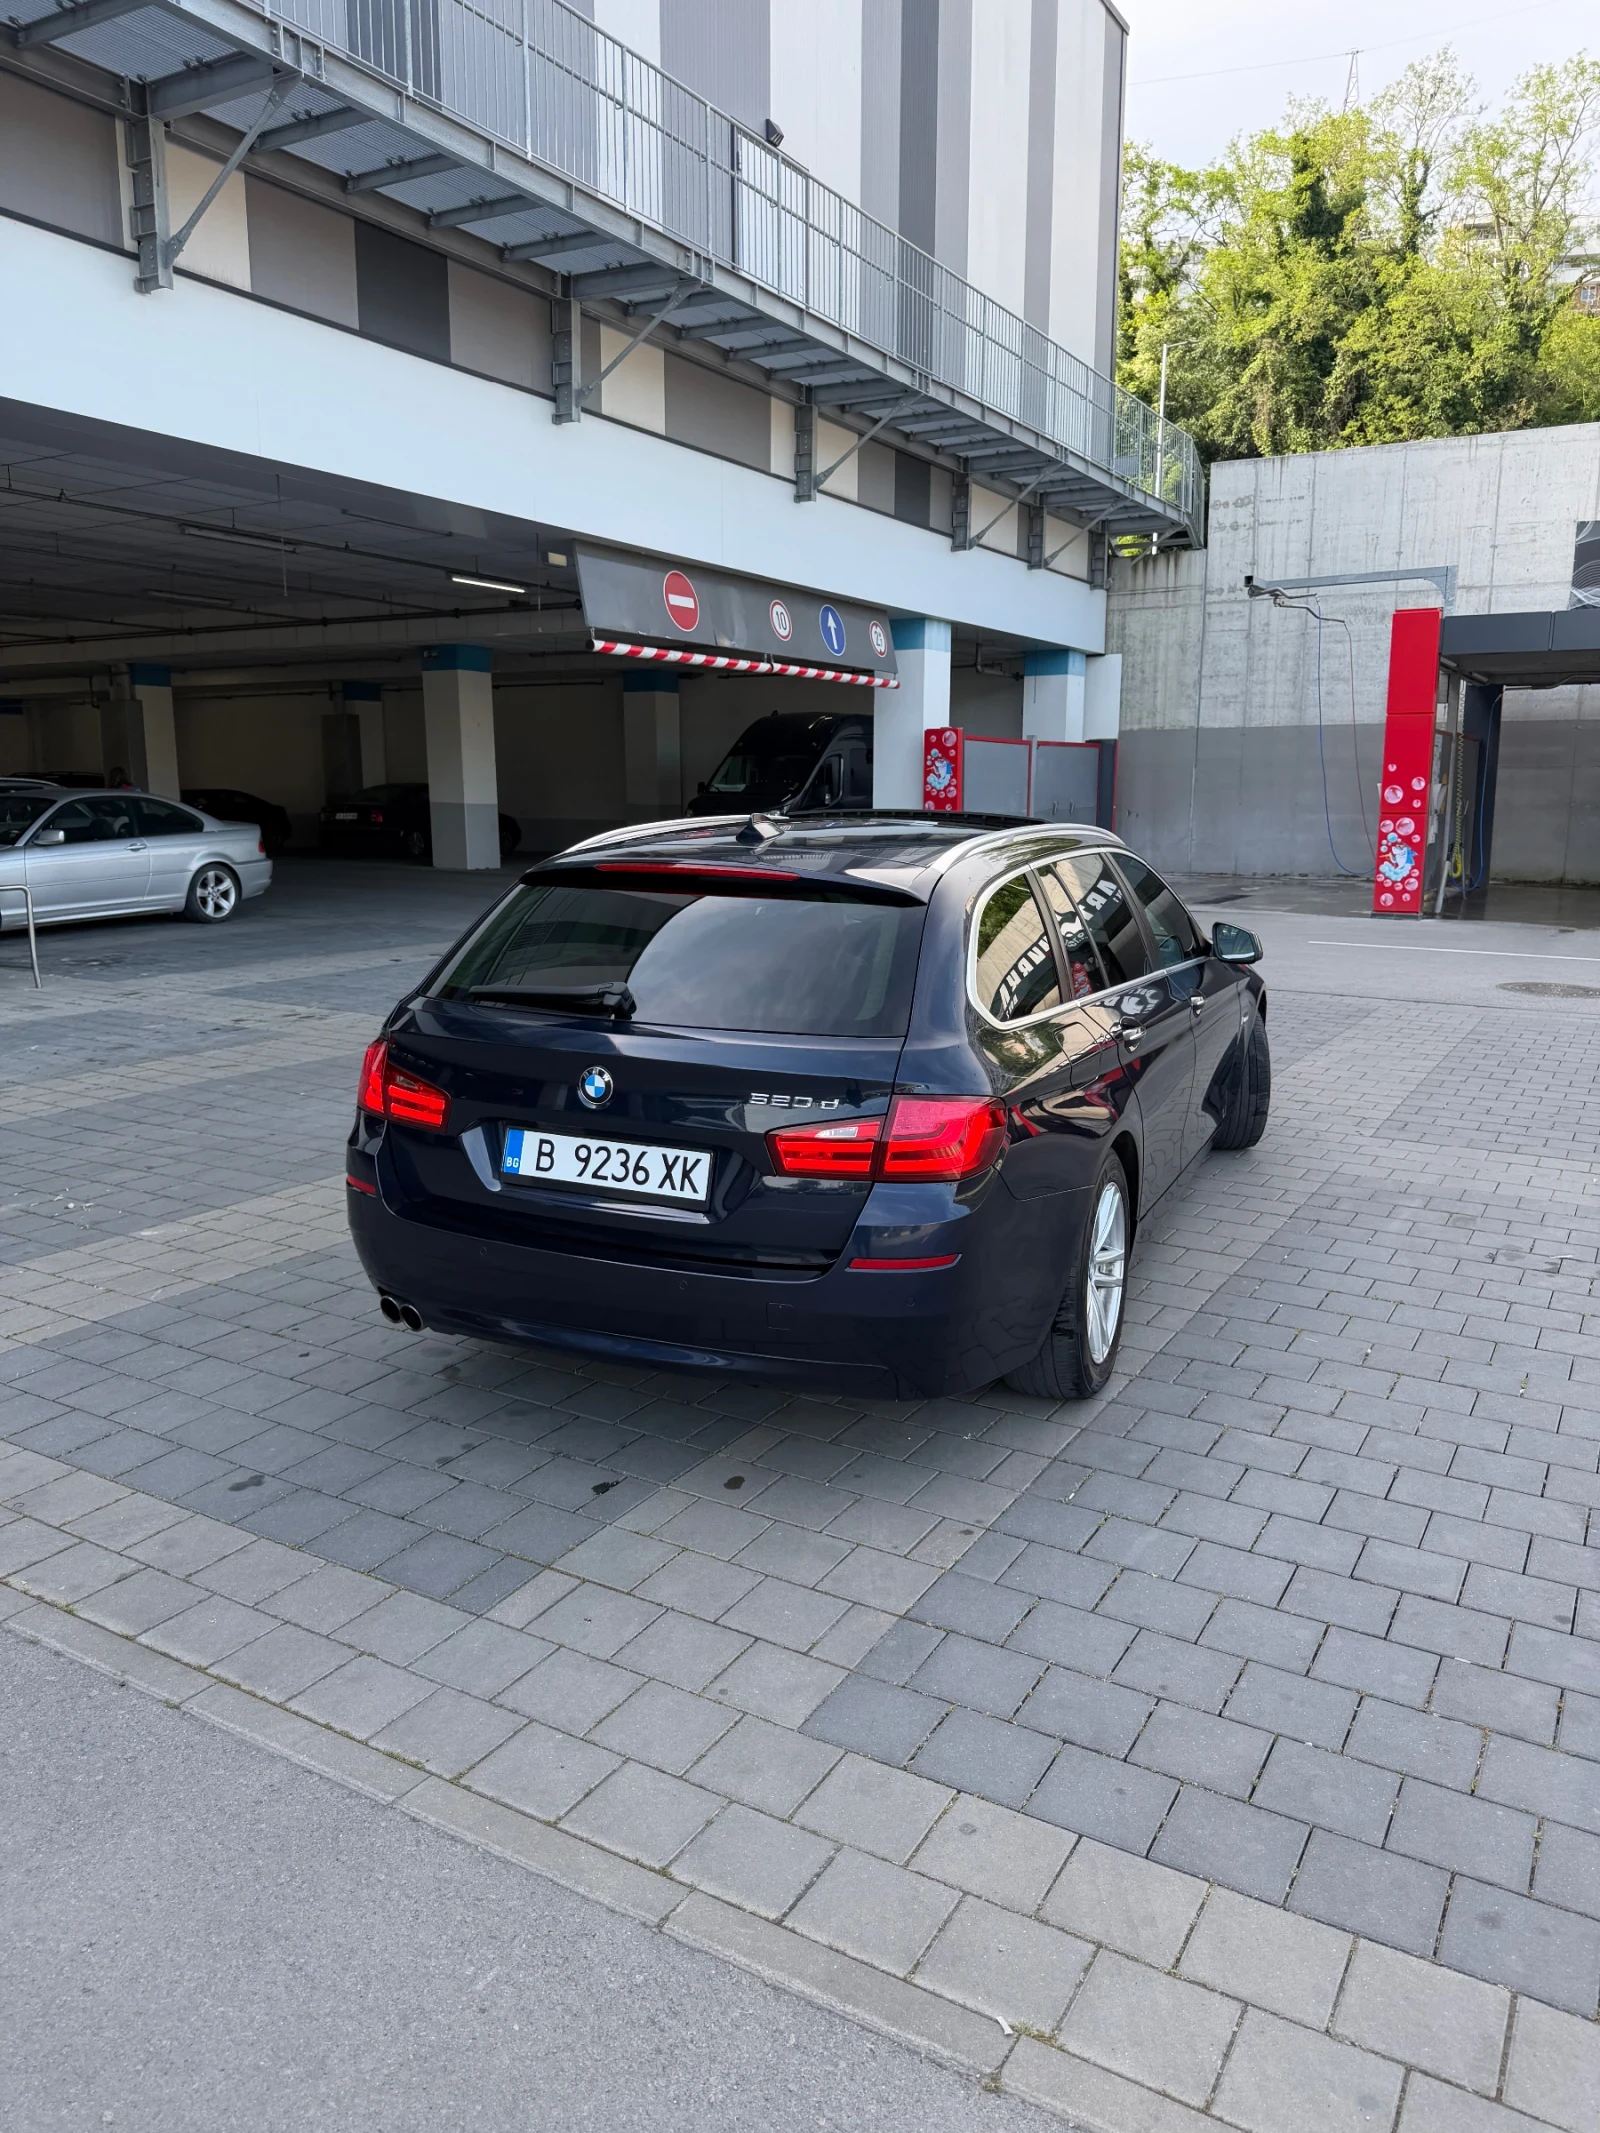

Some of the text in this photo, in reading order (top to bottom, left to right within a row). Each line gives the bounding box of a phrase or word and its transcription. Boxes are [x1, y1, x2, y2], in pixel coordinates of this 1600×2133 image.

[776, 611, 787, 630] 10
[505, 1156, 519, 1168] BG
[535, 1138, 702, 1194] B 9236 XK
